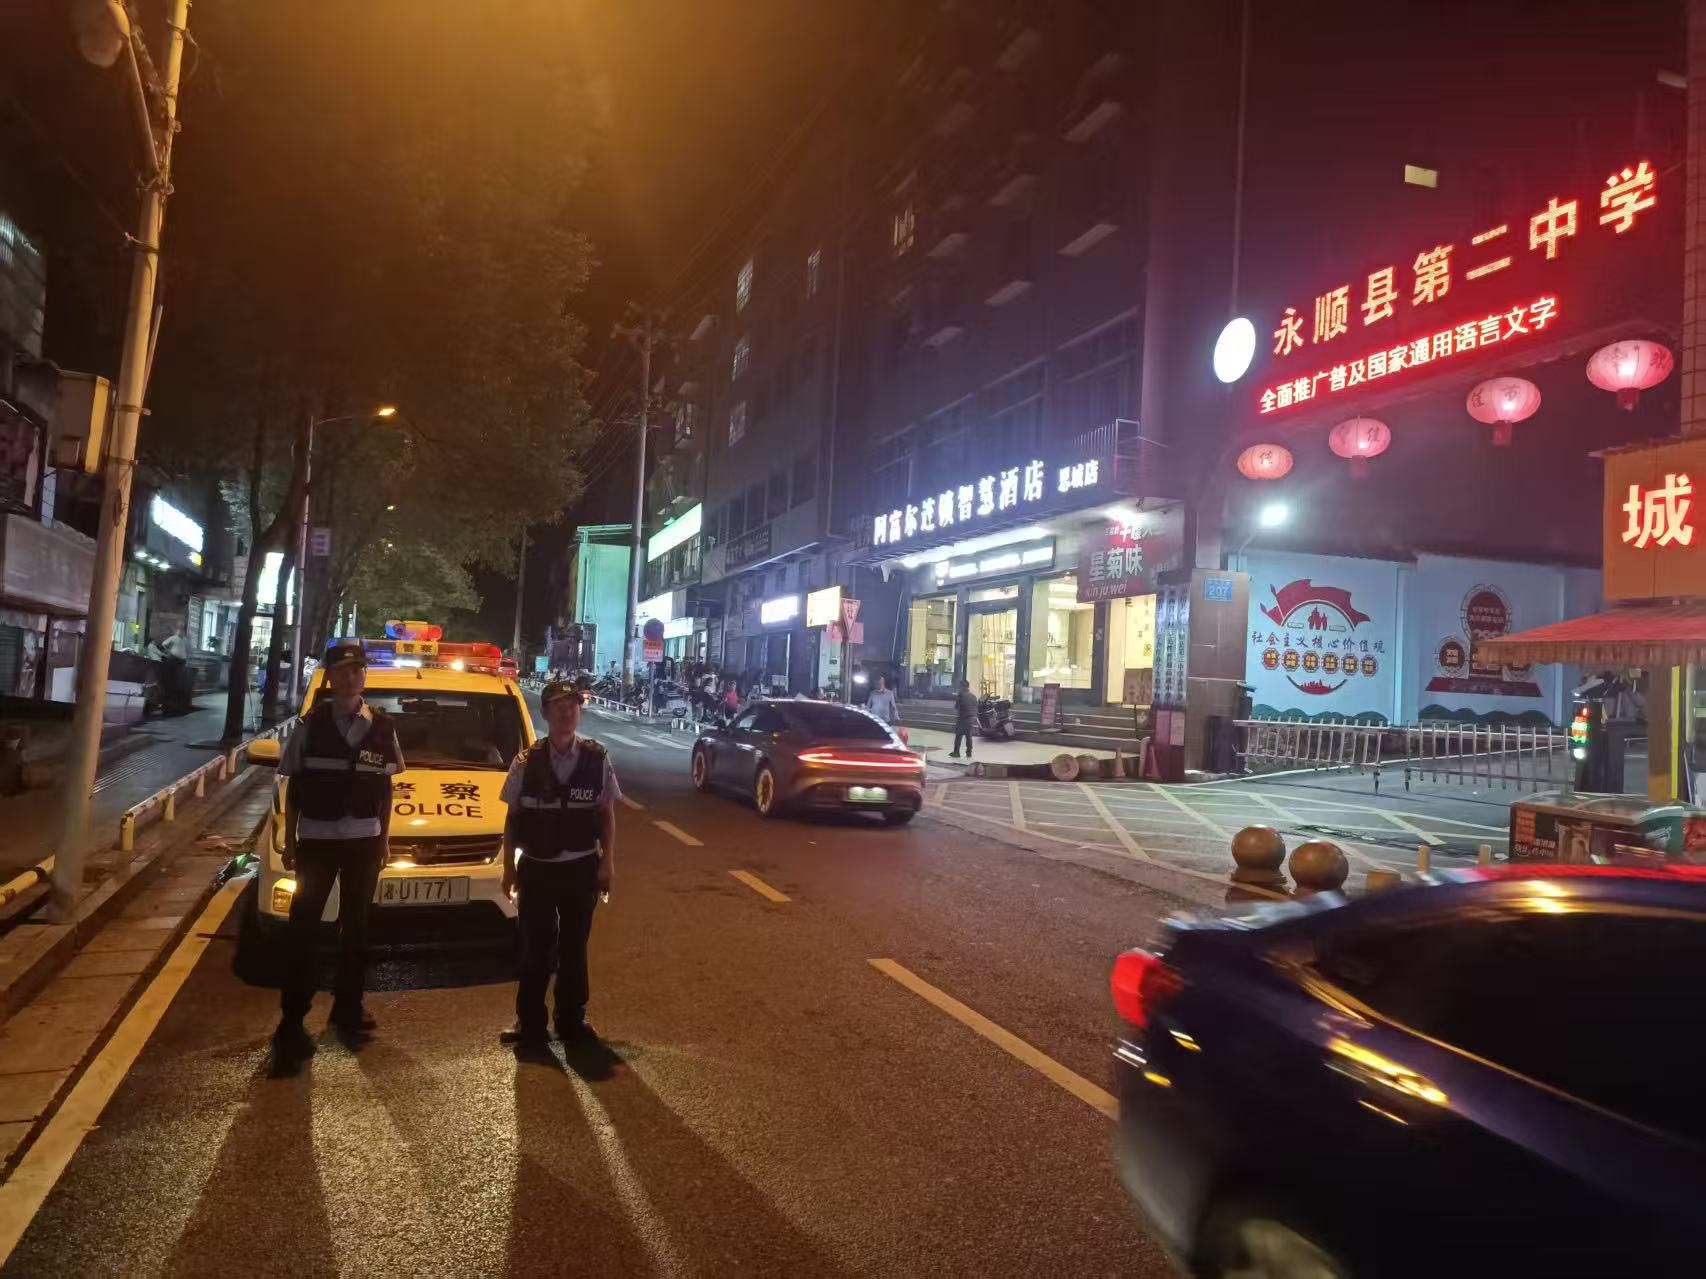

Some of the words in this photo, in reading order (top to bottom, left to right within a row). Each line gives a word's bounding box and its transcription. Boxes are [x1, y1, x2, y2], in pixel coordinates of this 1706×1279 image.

[1272, 160, 1658, 358] 永顺县第二中学
[1258, 295, 1559, 415] 全面推广普及国家通用语言文字
[1621, 472, 1695, 549] 城
[1251, 631, 1386, 654] 社会主义核心价值观
[359, 749, 384, 766] POLICE
[569, 787, 594, 801] POLICE
[393, 803, 483, 819] OLICE
